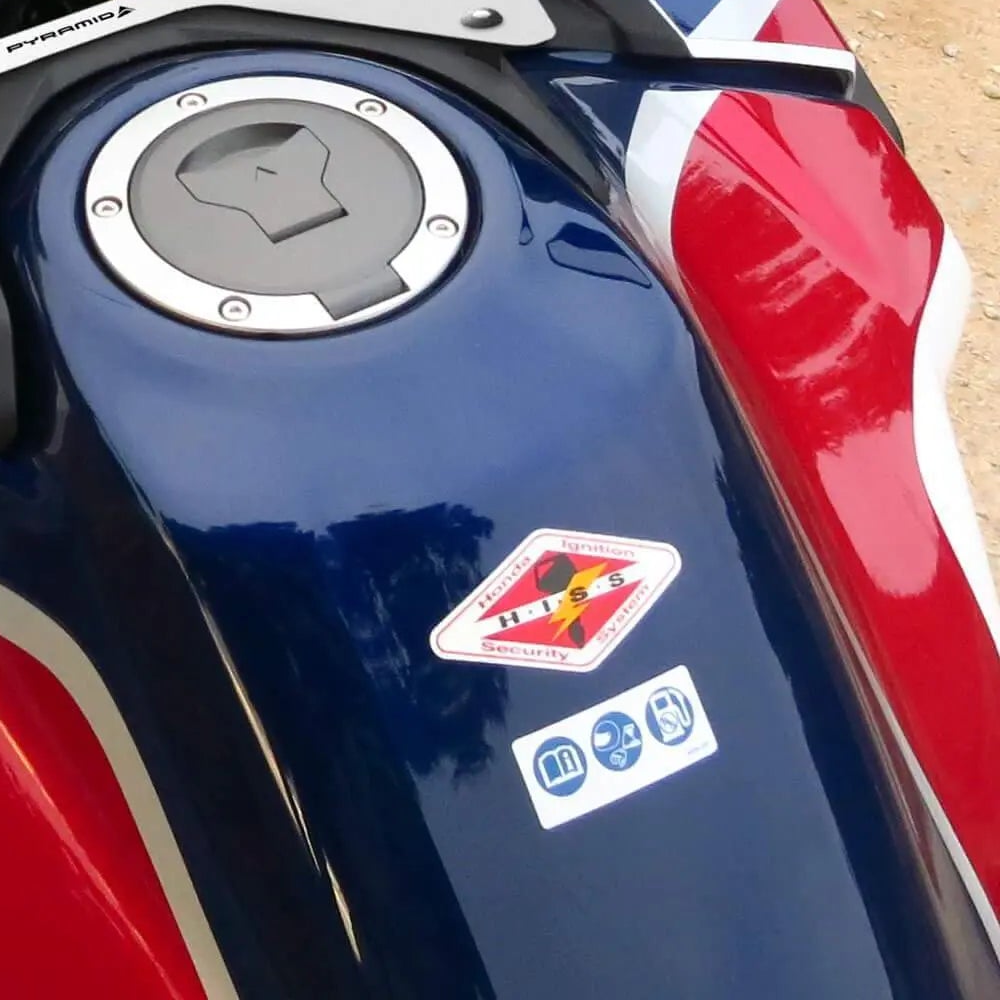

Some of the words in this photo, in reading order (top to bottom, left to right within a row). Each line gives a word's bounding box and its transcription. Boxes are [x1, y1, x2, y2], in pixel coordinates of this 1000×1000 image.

[6, 11, 115, 53] PYRAMID
[561, 539, 635, 558] Ignition
[477, 555, 532, 609] Honda
[596, 583, 650, 643] System
[480, 640, 569, 661] Security
